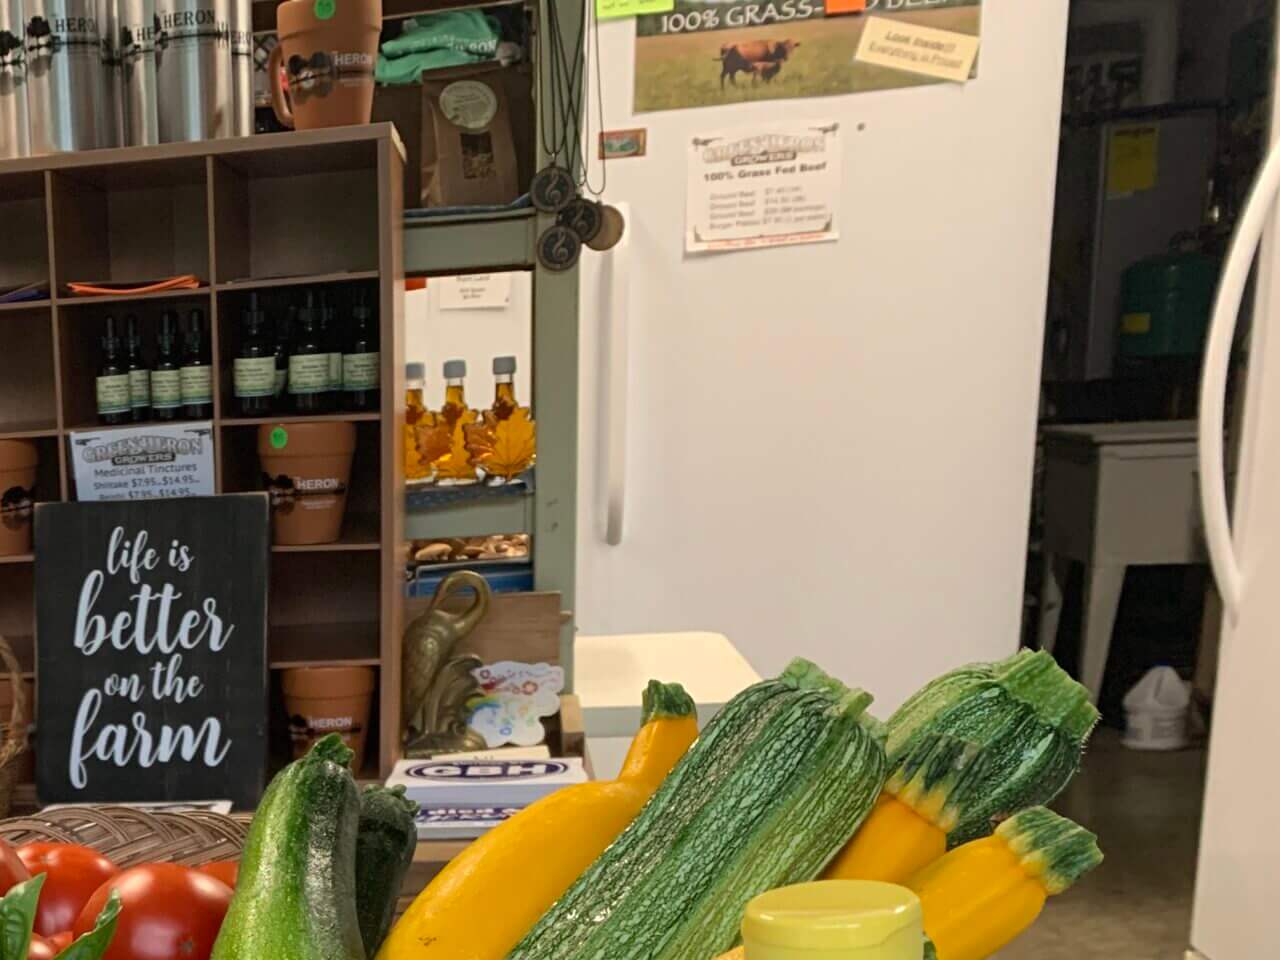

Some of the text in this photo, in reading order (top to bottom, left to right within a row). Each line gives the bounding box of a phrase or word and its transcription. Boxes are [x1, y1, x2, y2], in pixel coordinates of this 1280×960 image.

[163, 10, 216, 29] HERON
[661, 8, 720, 33] 100%
[704, 171, 734, 181] 100%
[94, 463, 198, 478] Medicinal Tinctures
[296, 478, 339, 490] HERON
[106, 526, 195, 585] life is
[74, 569, 235, 656] better
[104, 653, 205, 704] on the
[310, 716, 353, 728] HERON
[69, 688, 233, 790] farm
